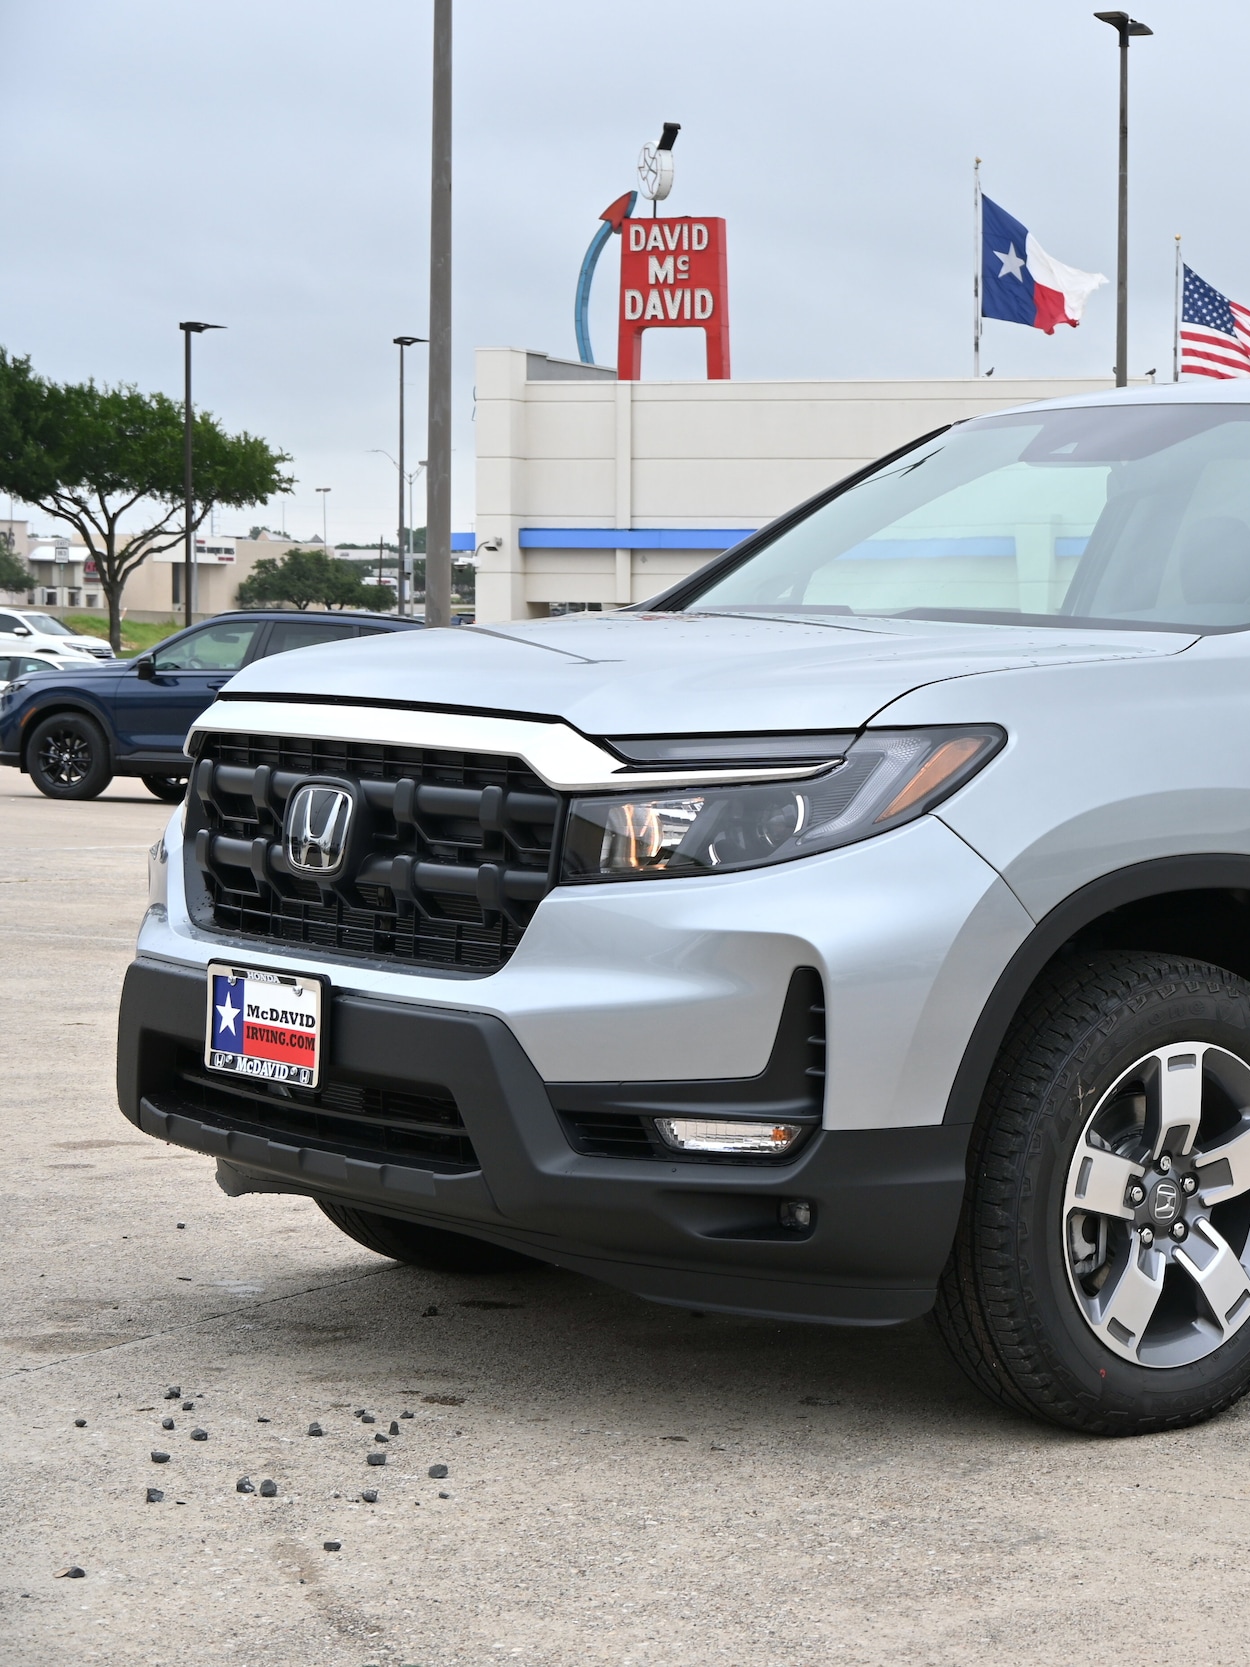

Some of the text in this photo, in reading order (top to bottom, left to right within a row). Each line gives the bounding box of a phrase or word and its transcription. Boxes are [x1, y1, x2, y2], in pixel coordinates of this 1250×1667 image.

[629, 223, 709, 252] DAVID
[648, 254, 690, 285] Mc
[624, 287, 714, 321] DAVID
[246, 971, 280, 984] HONDA
[247, 1003, 316, 1028] McDAVID
[246, 1025, 315, 1051] IRVING.COM
[235, 1057, 289, 1080] McDAVID
